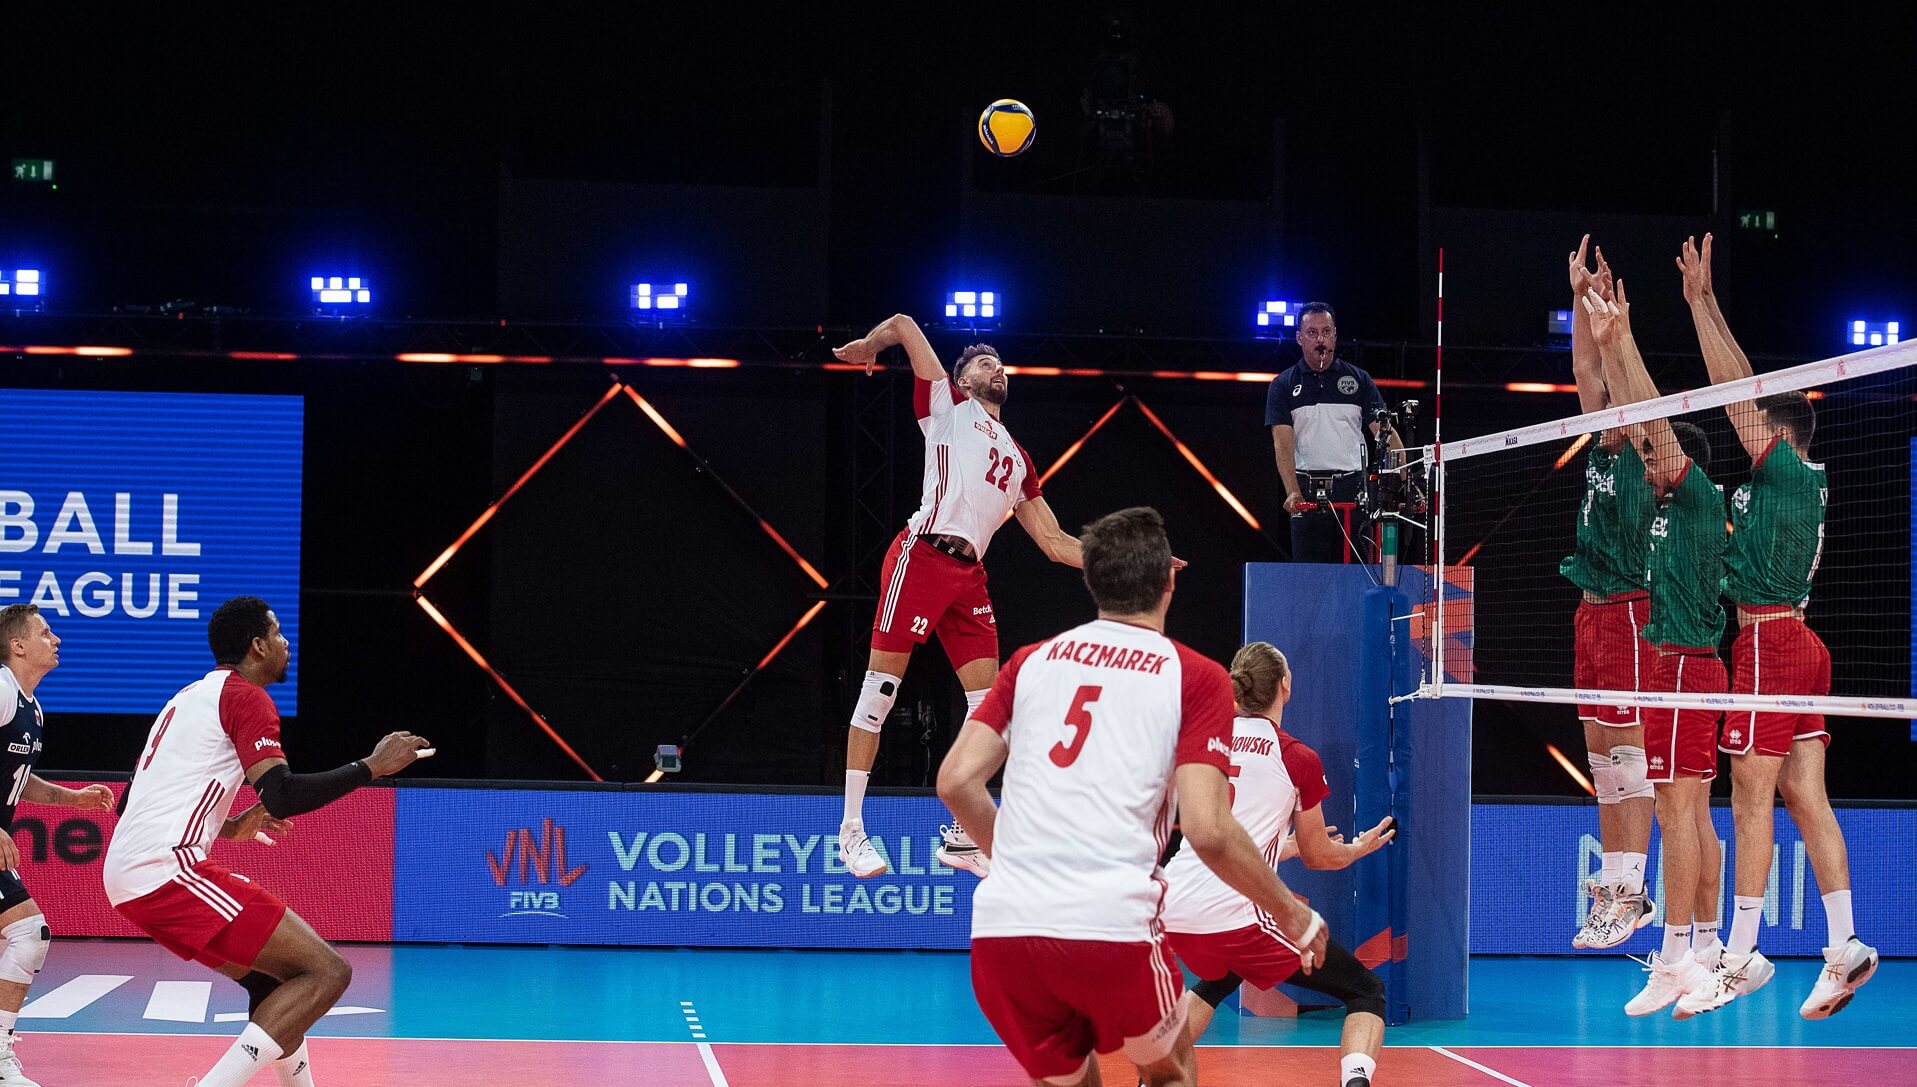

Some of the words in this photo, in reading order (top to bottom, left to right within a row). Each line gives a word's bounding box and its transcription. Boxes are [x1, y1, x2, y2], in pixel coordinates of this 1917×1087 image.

[985, 447, 1014, 493] 22
[0, 490, 201, 556] BALL
[910, 616, 928, 635] 22
[1046, 641, 1170, 675] KACZMAREK
[143, 706, 177, 771] 9
[1048, 685, 1103, 768] 5
[485, 817, 588, 887] VNL
[509, 891, 560, 909] FIVB
[608, 880, 784, 913] NATIONS
[801, 883, 955, 915] LEAGUE
